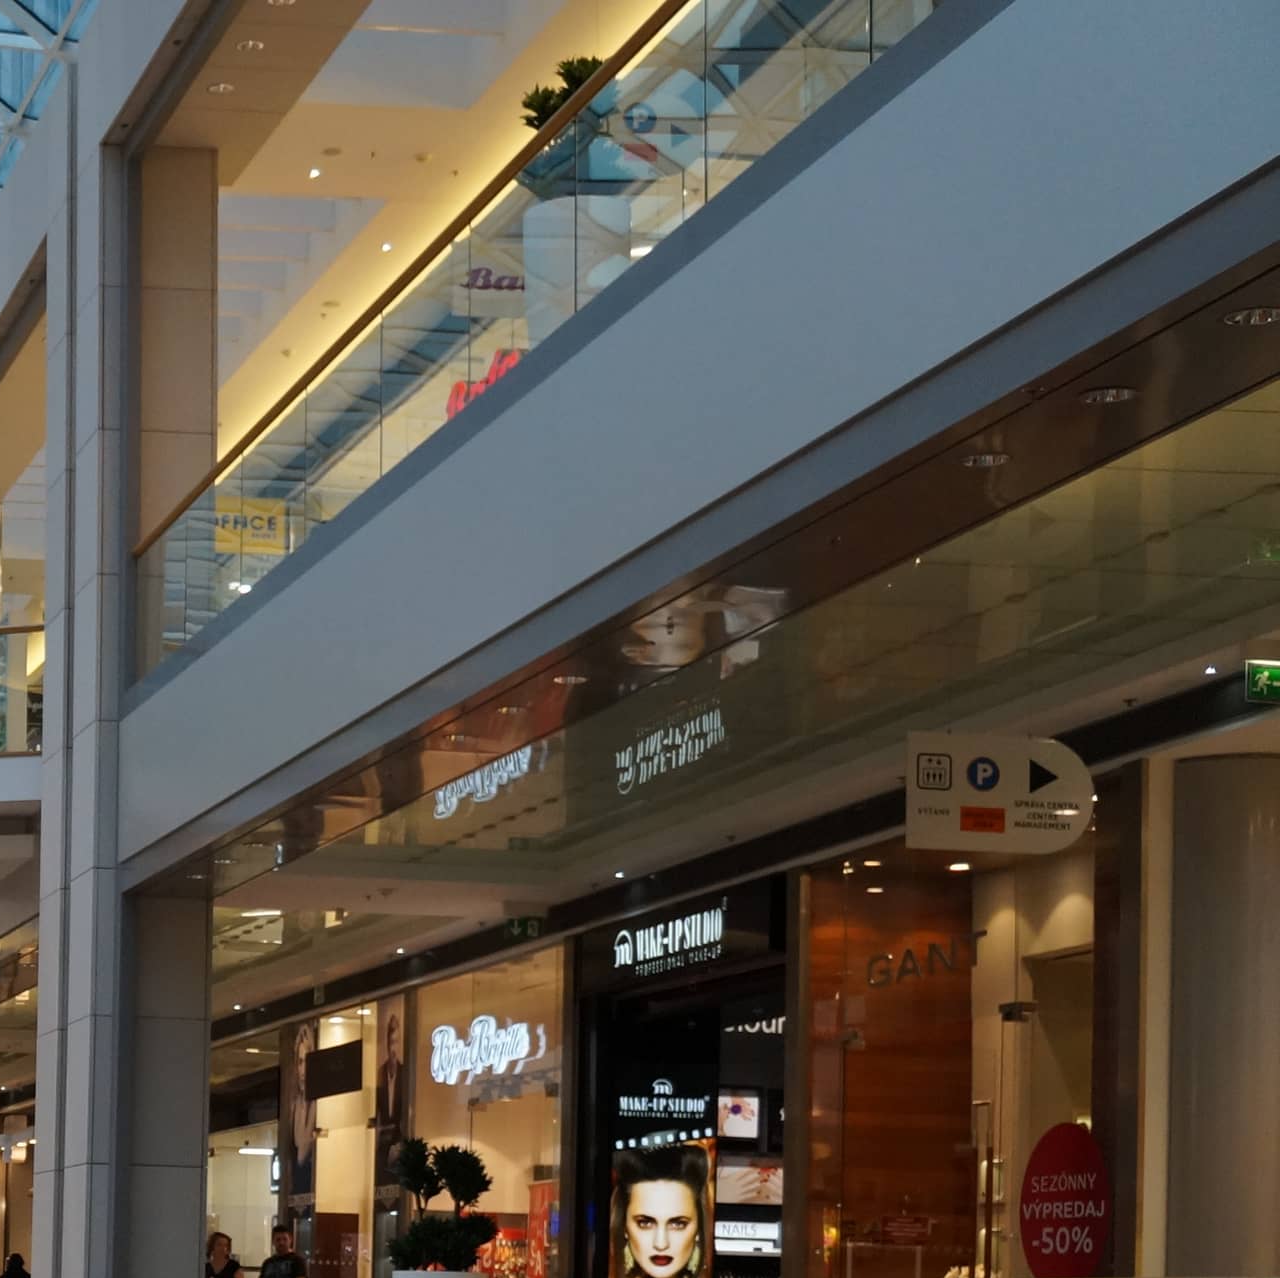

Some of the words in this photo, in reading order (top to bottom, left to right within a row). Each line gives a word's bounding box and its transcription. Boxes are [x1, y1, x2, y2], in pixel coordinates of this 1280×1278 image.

[215, 514, 277, 530] FFICE
[1023, 1198, 1105, 1220] VÝPREDAJ
[1031, 1225, 1094, 1254] -50%
